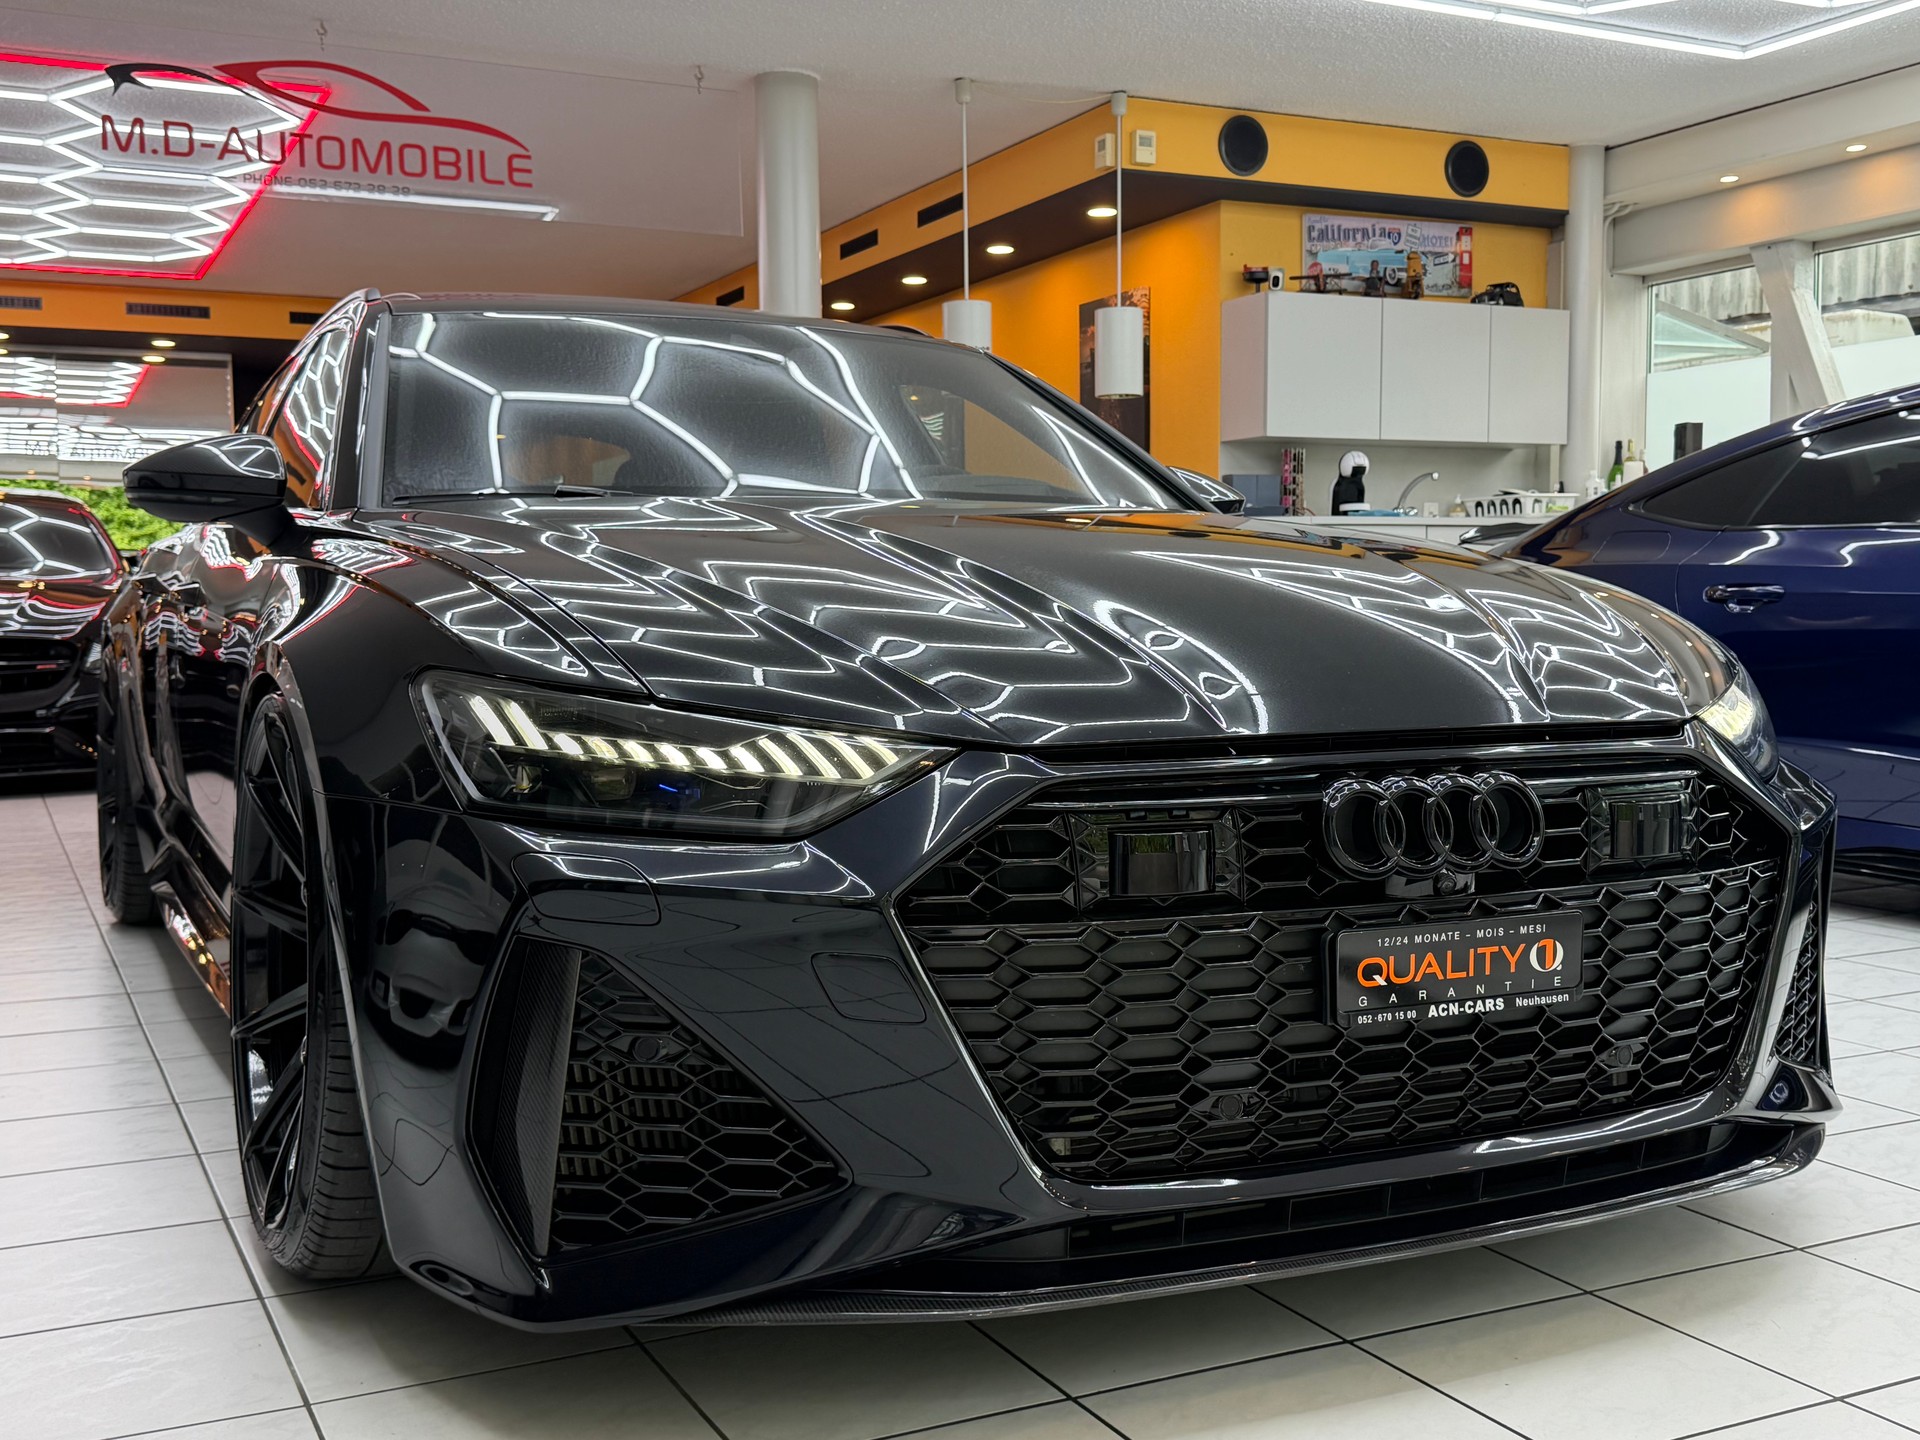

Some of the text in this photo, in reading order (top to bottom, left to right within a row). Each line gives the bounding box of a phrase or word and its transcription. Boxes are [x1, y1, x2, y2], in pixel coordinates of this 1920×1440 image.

[100, 114, 534, 189] M.D-AUTOMOBILE
[243, 174, 293, 187] PHONE
[1307, 224, 1387, 243] California
[1377, 936, 1409, 947] 12/24
[1414, 931, 1460, 944] MONATE
[1476, 927, 1504, 939] MOIS
[1519, 923, 1546, 936] MESI
[1356, 943, 1526, 988] QUALITY
[1358, 976, 1562, 1007] GARANTIE
[1428, 997, 1505, 1018] ACN-CARS
[1515, 993, 1569, 1007] Neuhausen
